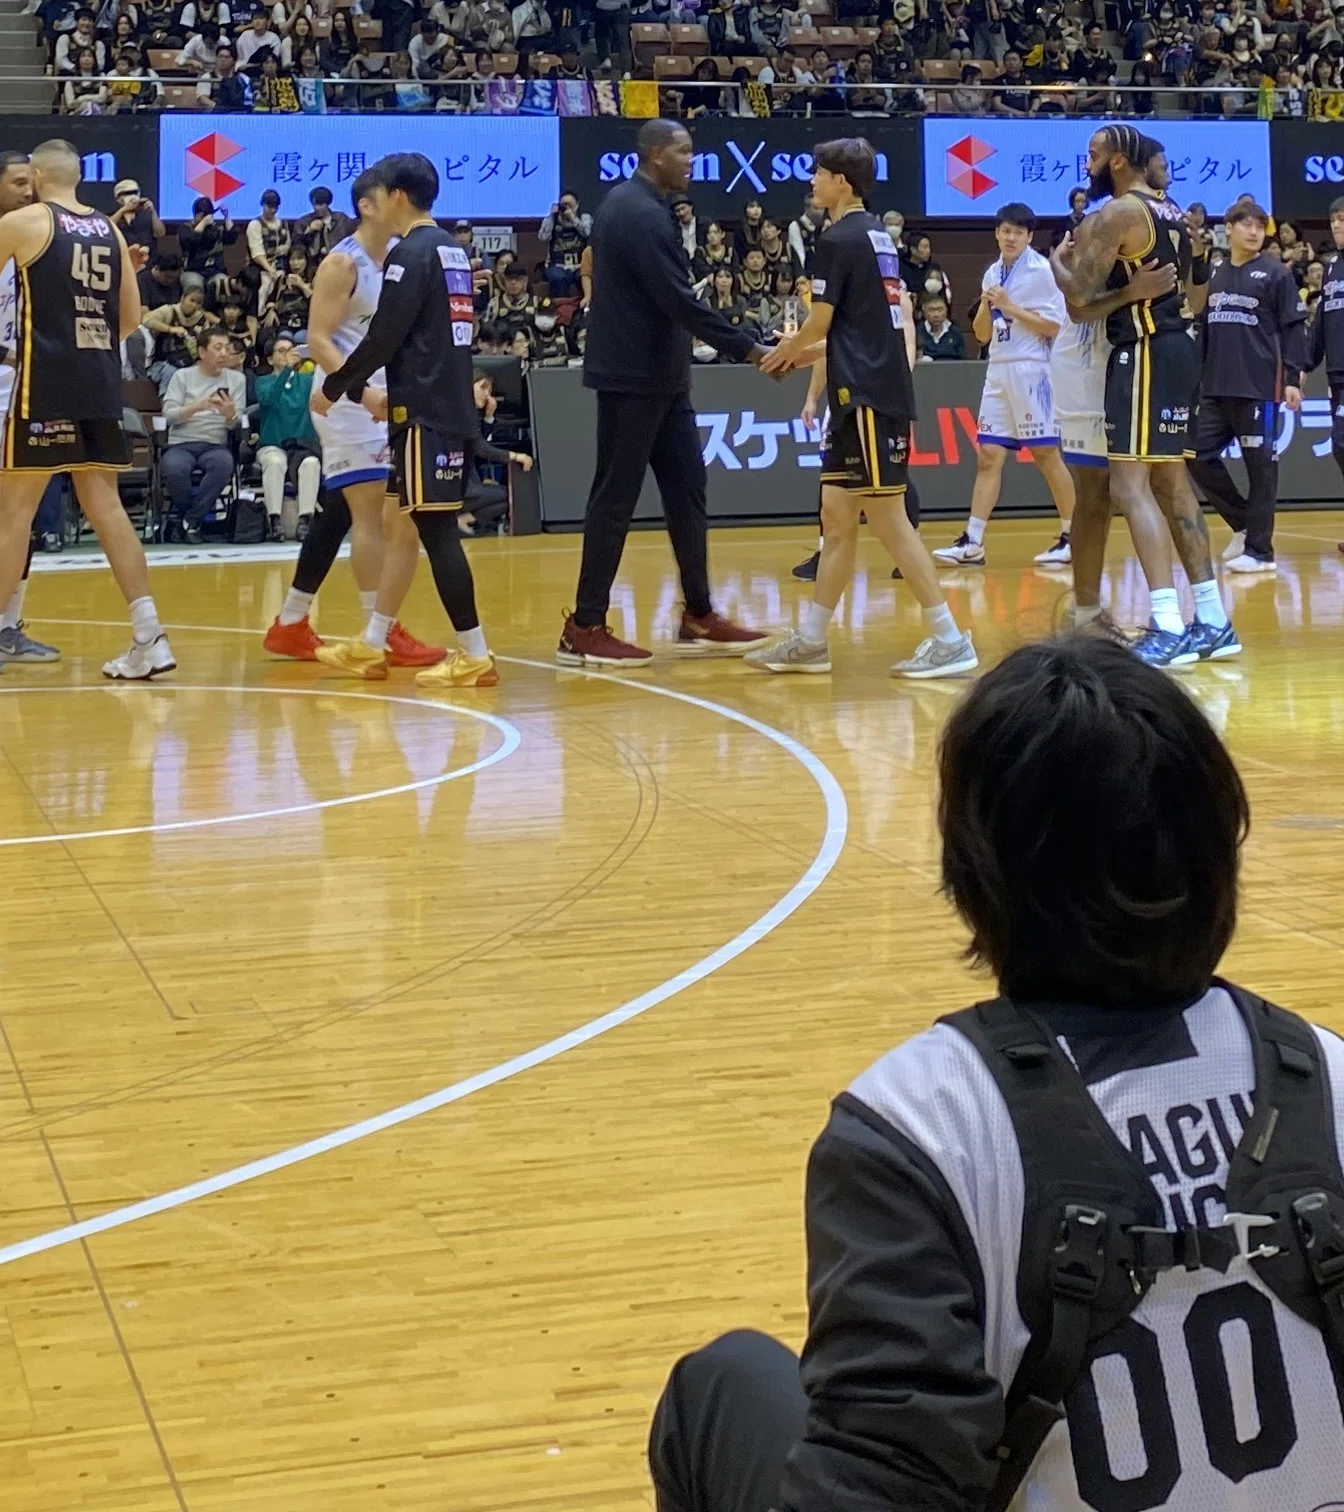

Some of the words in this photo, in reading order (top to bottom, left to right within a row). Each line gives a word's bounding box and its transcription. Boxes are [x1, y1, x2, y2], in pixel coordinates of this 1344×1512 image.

[271, 152, 539, 185] 霞ヶ関ピタル
[58, 212, 111, 238] やまや
[71, 243, 112, 292] 45
